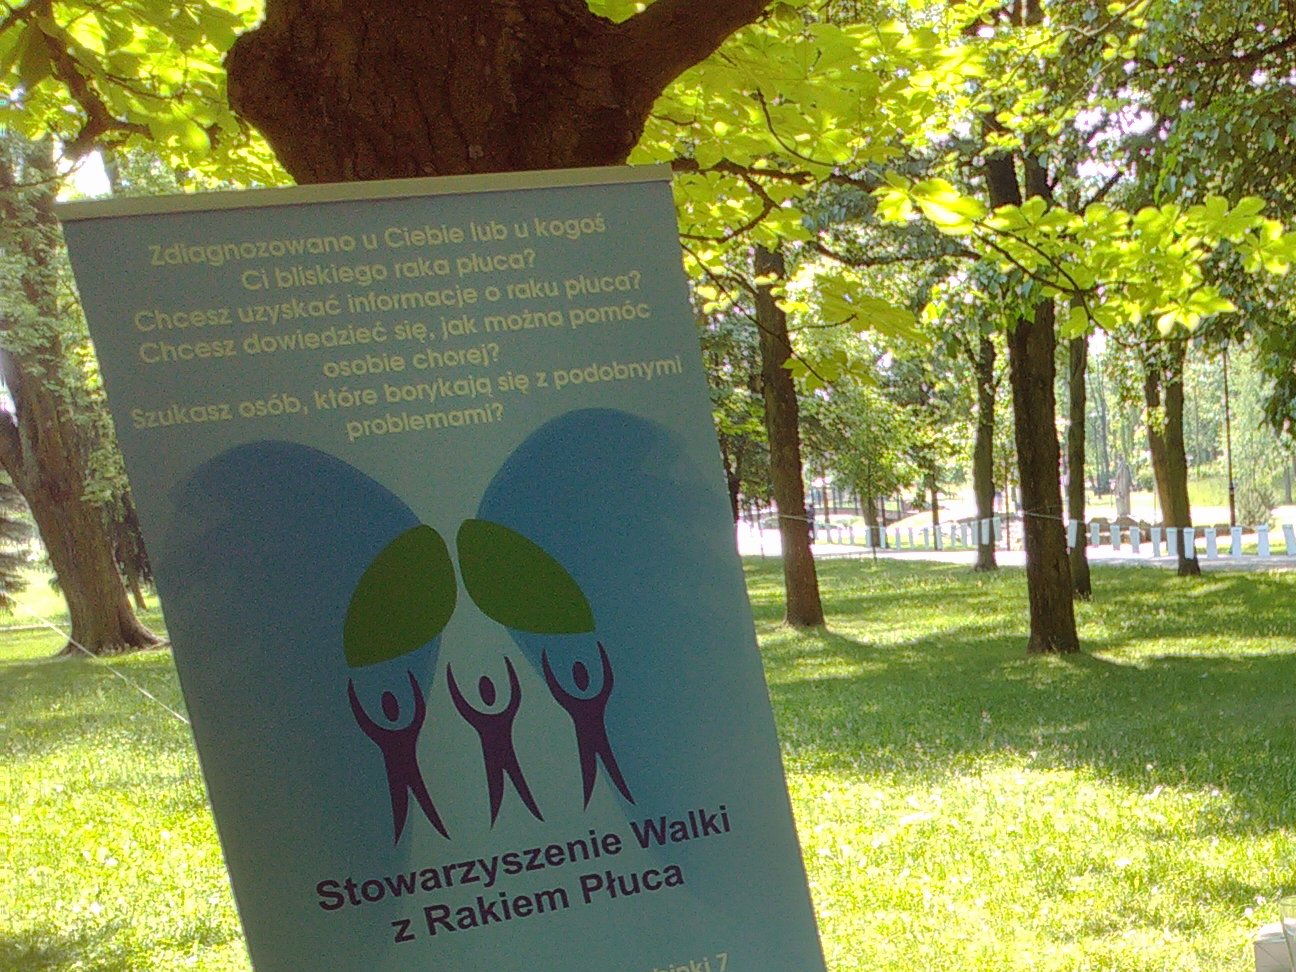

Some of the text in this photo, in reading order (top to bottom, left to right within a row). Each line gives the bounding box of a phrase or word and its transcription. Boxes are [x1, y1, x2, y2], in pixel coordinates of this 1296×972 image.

[150, 212, 606, 267] Zdiagnozowano u Ciebie lub u kogoś
[242, 249, 536, 290] Ci bliskiego raka płuca?
[134, 270, 641, 331] Chcesz uzyskać informacje o raku płuca?
[138, 301, 650, 363] Chcesz dowiedzieć się, jak można pomóc
[323, 342, 500, 378] osobie chorej?
[131, 355, 684, 429] Szukasz osób, które borykają się z podobnymi
[346, 402, 504, 442] problemami?
[315, 804, 731, 911] Stowarzyszenie Walki
[391, 864, 685, 944] z Rakiem Płuca
[716, 953, 728, 972] 7
